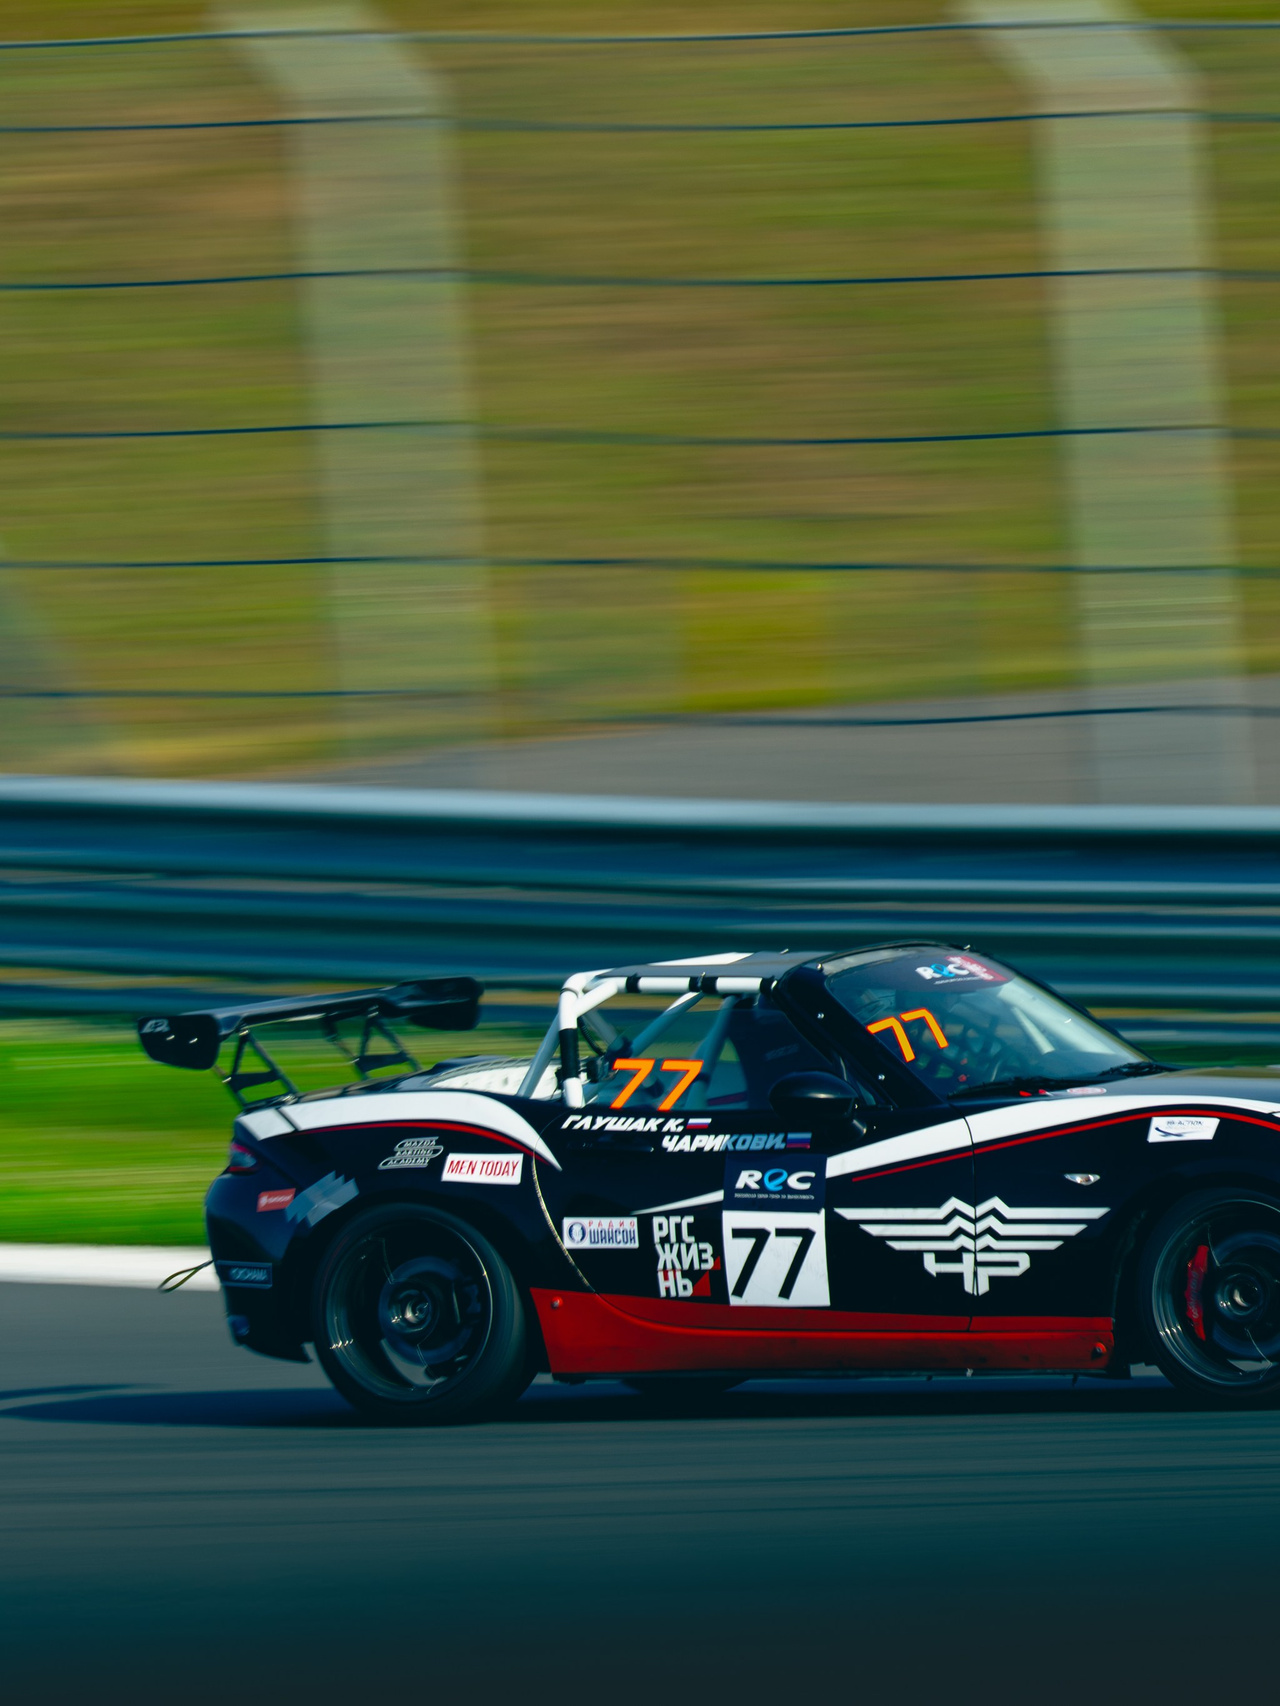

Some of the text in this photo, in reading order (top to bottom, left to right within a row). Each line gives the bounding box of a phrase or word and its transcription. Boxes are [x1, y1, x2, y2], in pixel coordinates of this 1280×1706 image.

[866, 1008, 949, 1063] 77
[610, 1058, 704, 1112] 77
[561, 1115, 664, 1132] ГЛУШАК
[447, 1160, 519, 1177] MEN TODAY
[588, 1220, 635, 1229] РАДИО
[589, 1228, 637, 1245] ШАНСОН
[653, 1216, 696, 1244] РГС
[656, 1242, 714, 1271] ЖИЗ
[730, 1227, 817, 1300] 77
[657, 1269, 694, 1298] НЬ
